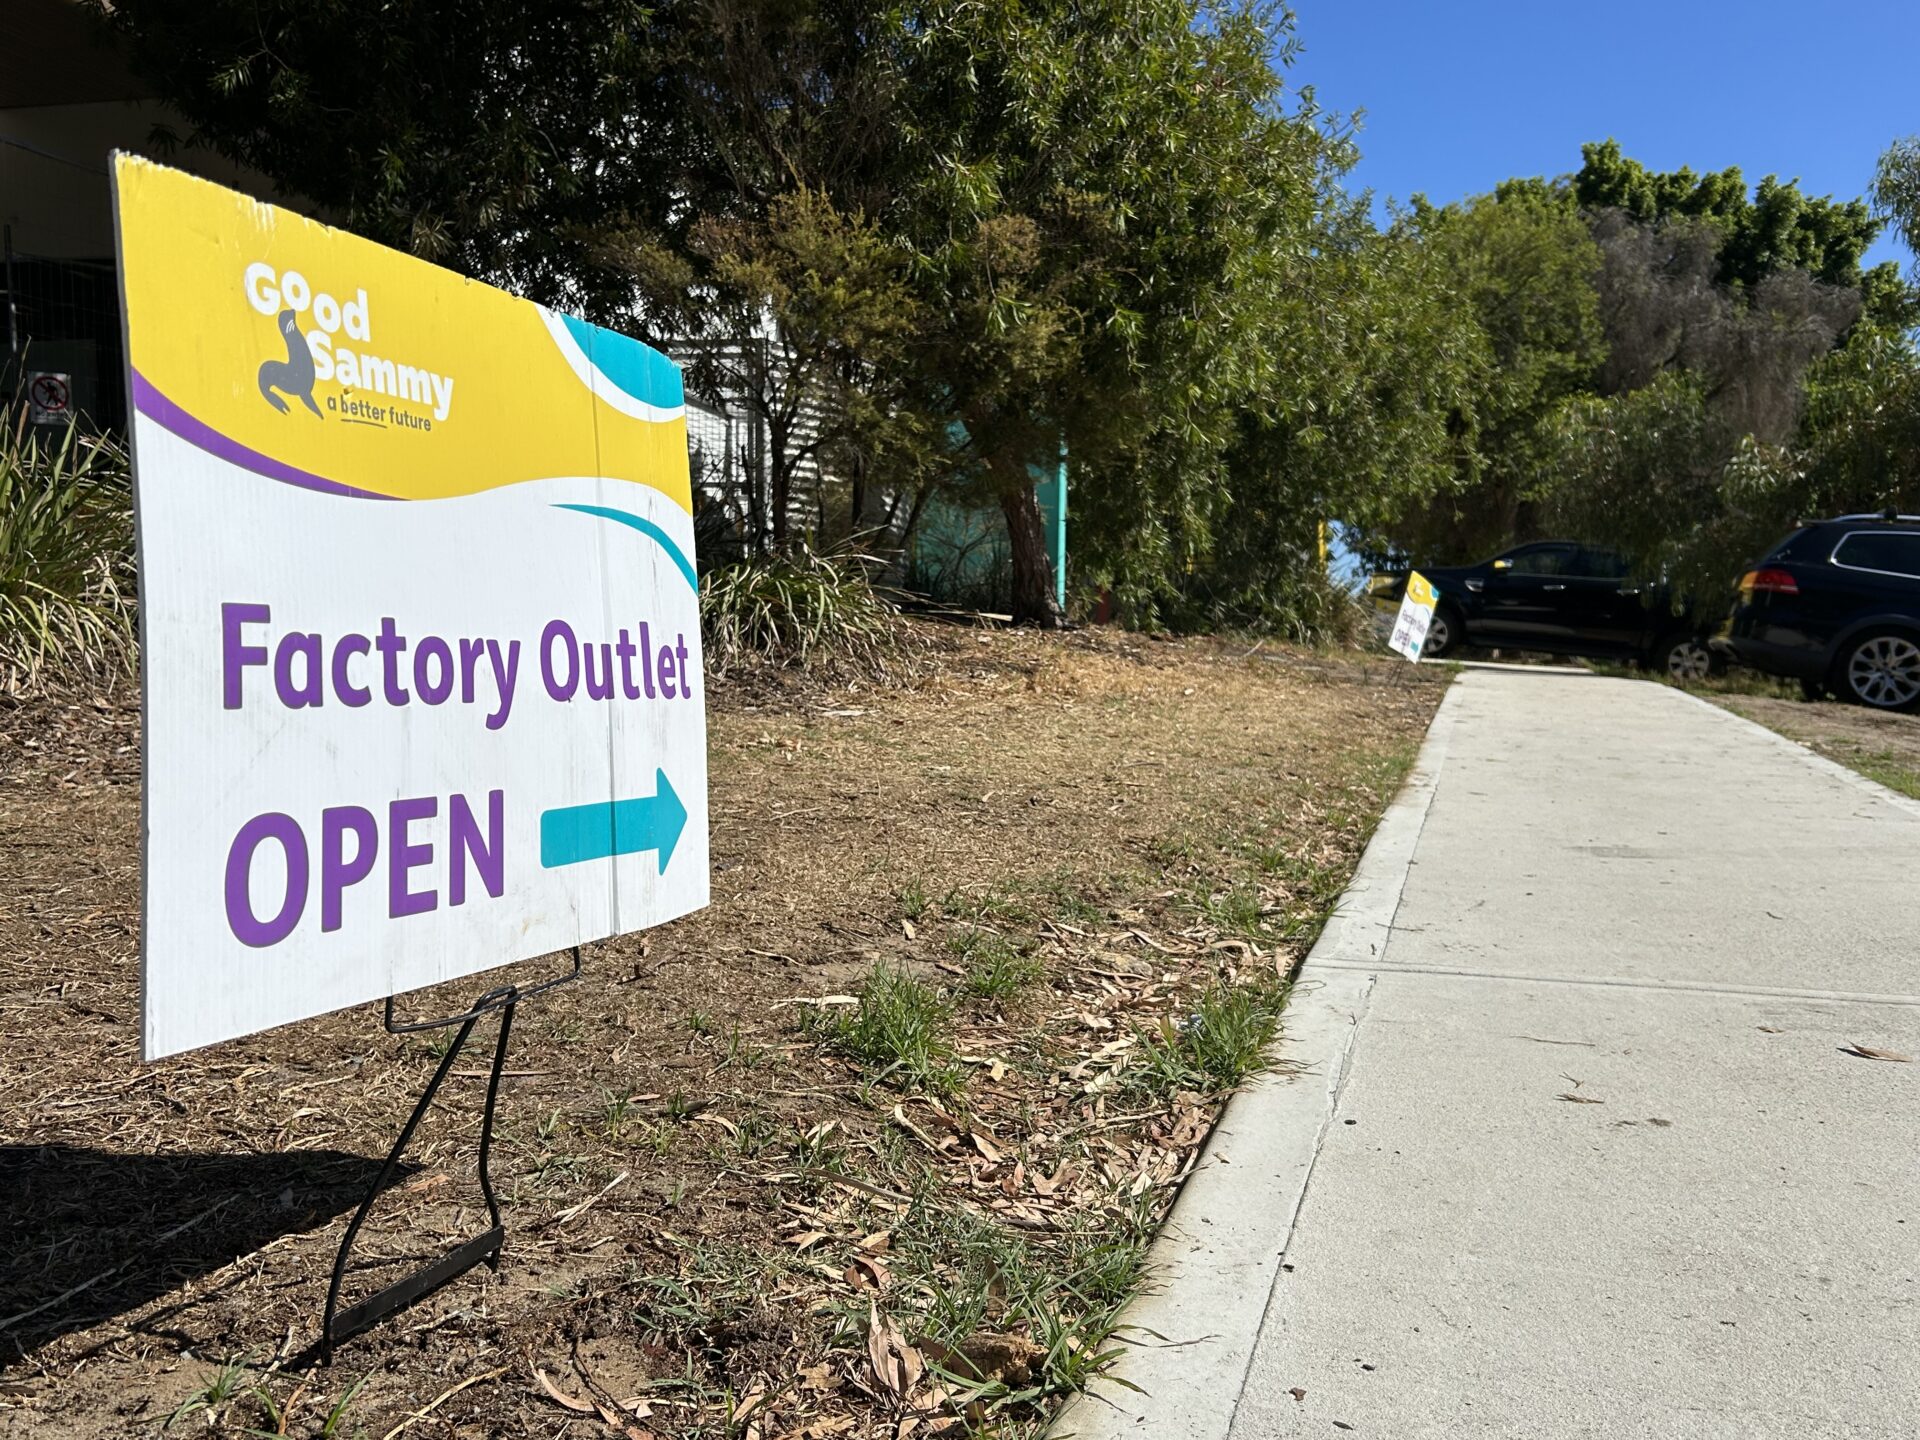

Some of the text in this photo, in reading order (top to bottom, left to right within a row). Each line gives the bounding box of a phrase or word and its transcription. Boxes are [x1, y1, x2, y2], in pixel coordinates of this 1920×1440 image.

[243, 261, 371, 343] Good
[305, 329, 454, 422] Sammy
[327, 393, 432, 432] a better future
[221, 602, 692, 730] Factory Outlet
[224, 789, 504, 948] OPEN
